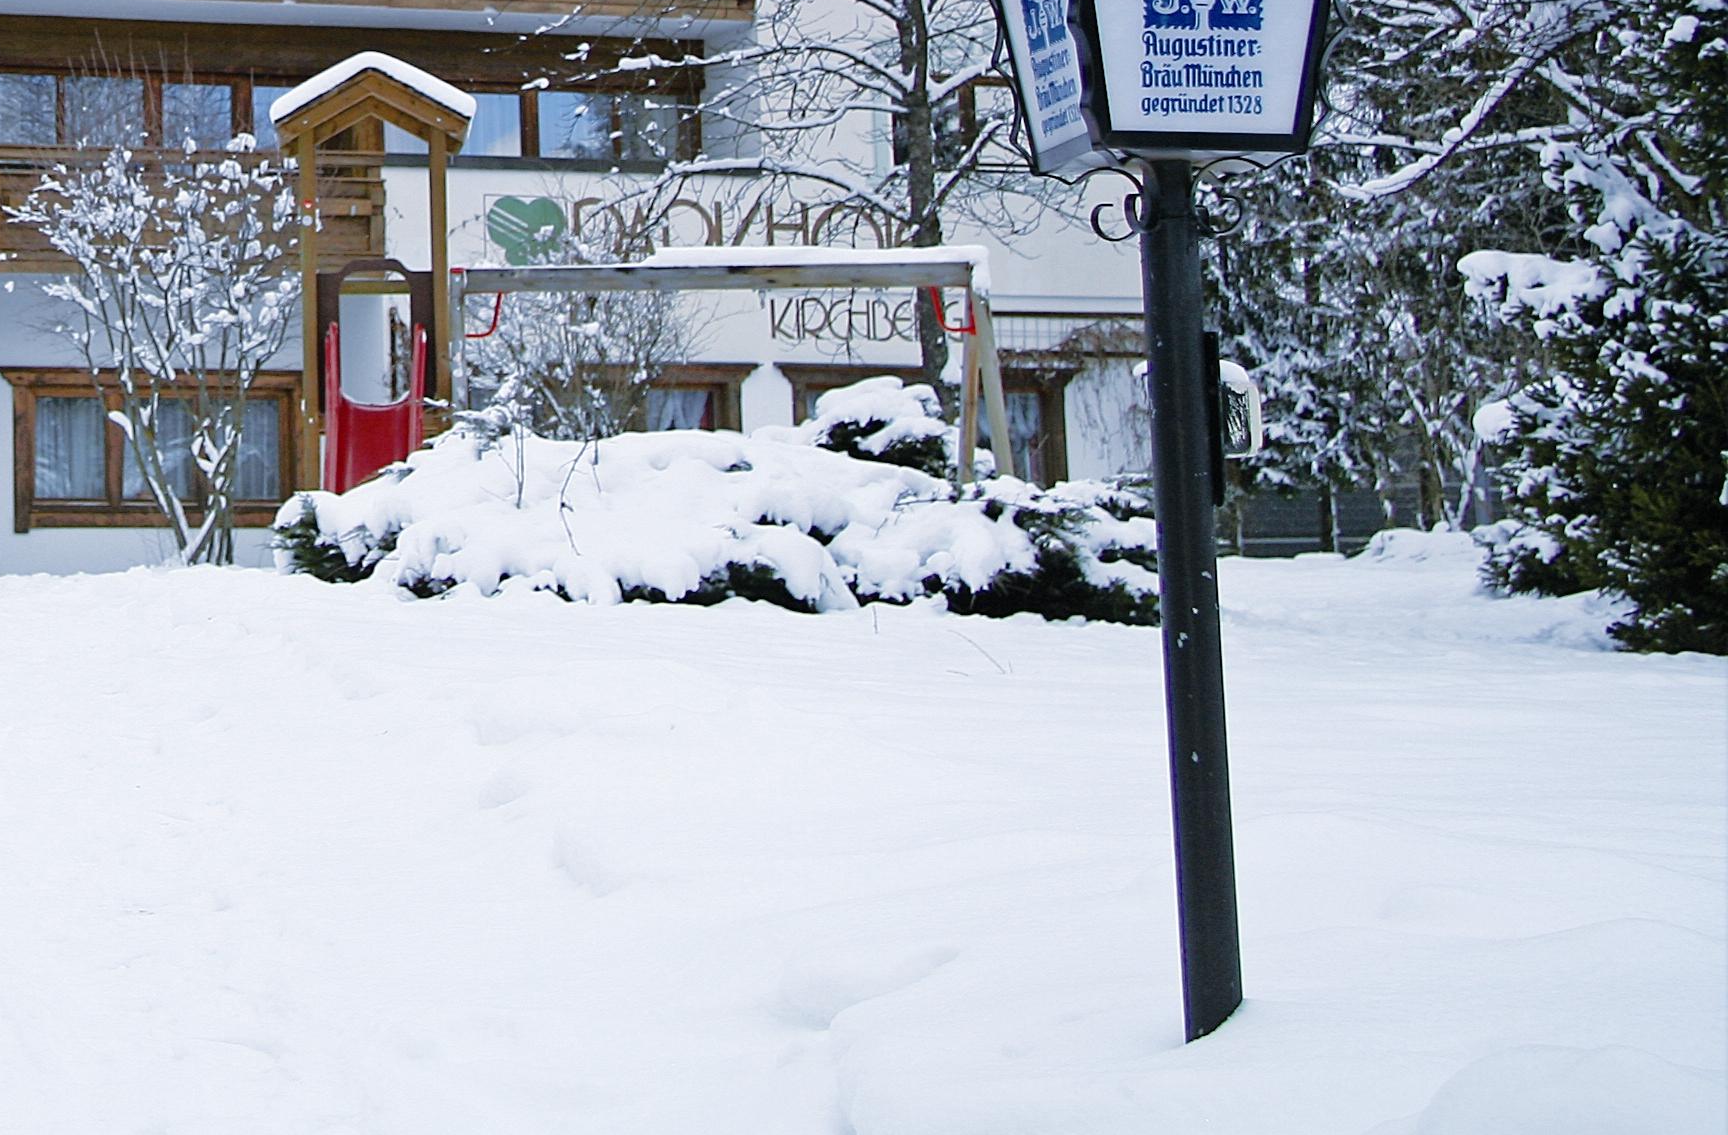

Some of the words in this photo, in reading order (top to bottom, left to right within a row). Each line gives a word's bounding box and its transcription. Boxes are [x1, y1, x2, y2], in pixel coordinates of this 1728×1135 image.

[1141, 93, 1225, 116] gegründet
[1228, 94, 1263, 115] 1328
[770, 296, 964, 342] KIRCHBEG
